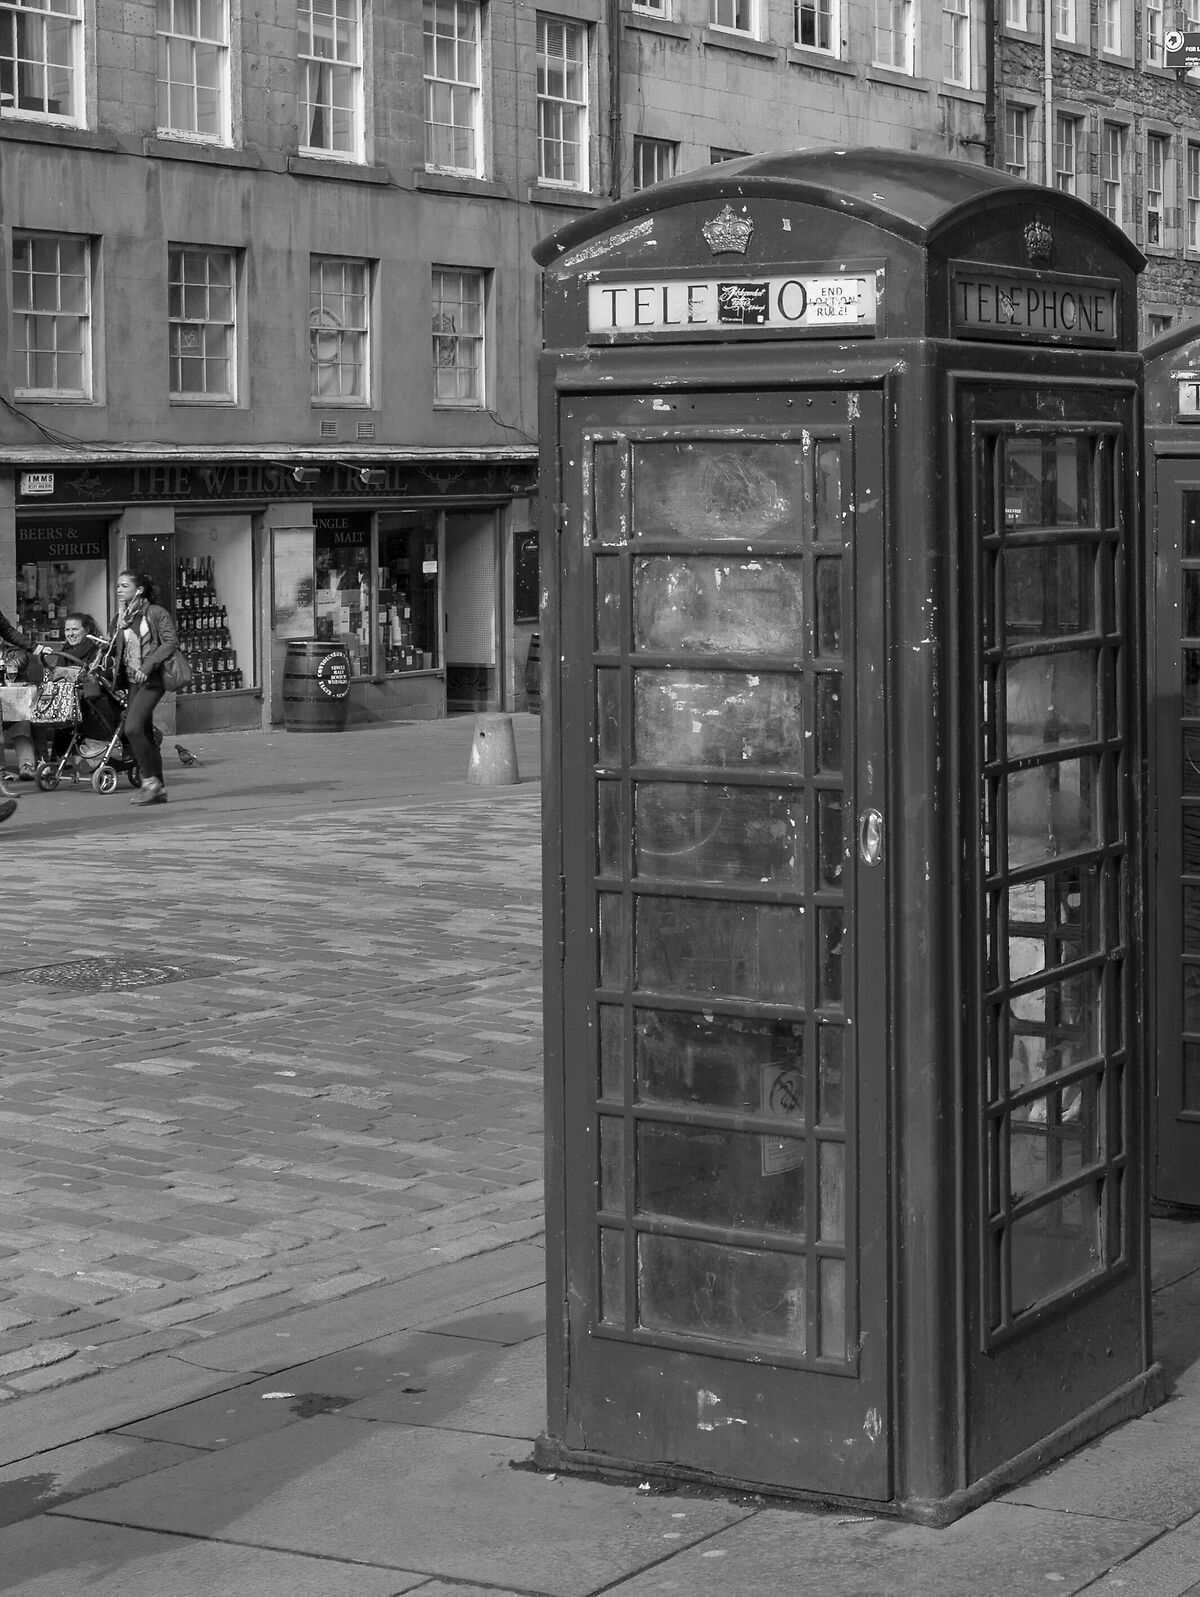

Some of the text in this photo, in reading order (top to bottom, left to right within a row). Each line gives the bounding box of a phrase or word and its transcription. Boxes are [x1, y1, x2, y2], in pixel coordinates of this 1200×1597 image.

[821, 287, 843, 296] END
[957, 281, 1106, 333] TELEPHONE
[128, 466, 192, 495] THE
[314, 518, 349, 529] INGLE
[20, 527, 79, 541] BEERS &
[334, 531, 366, 543] MALT
[48, 542, 100, 556] SPIRITS
